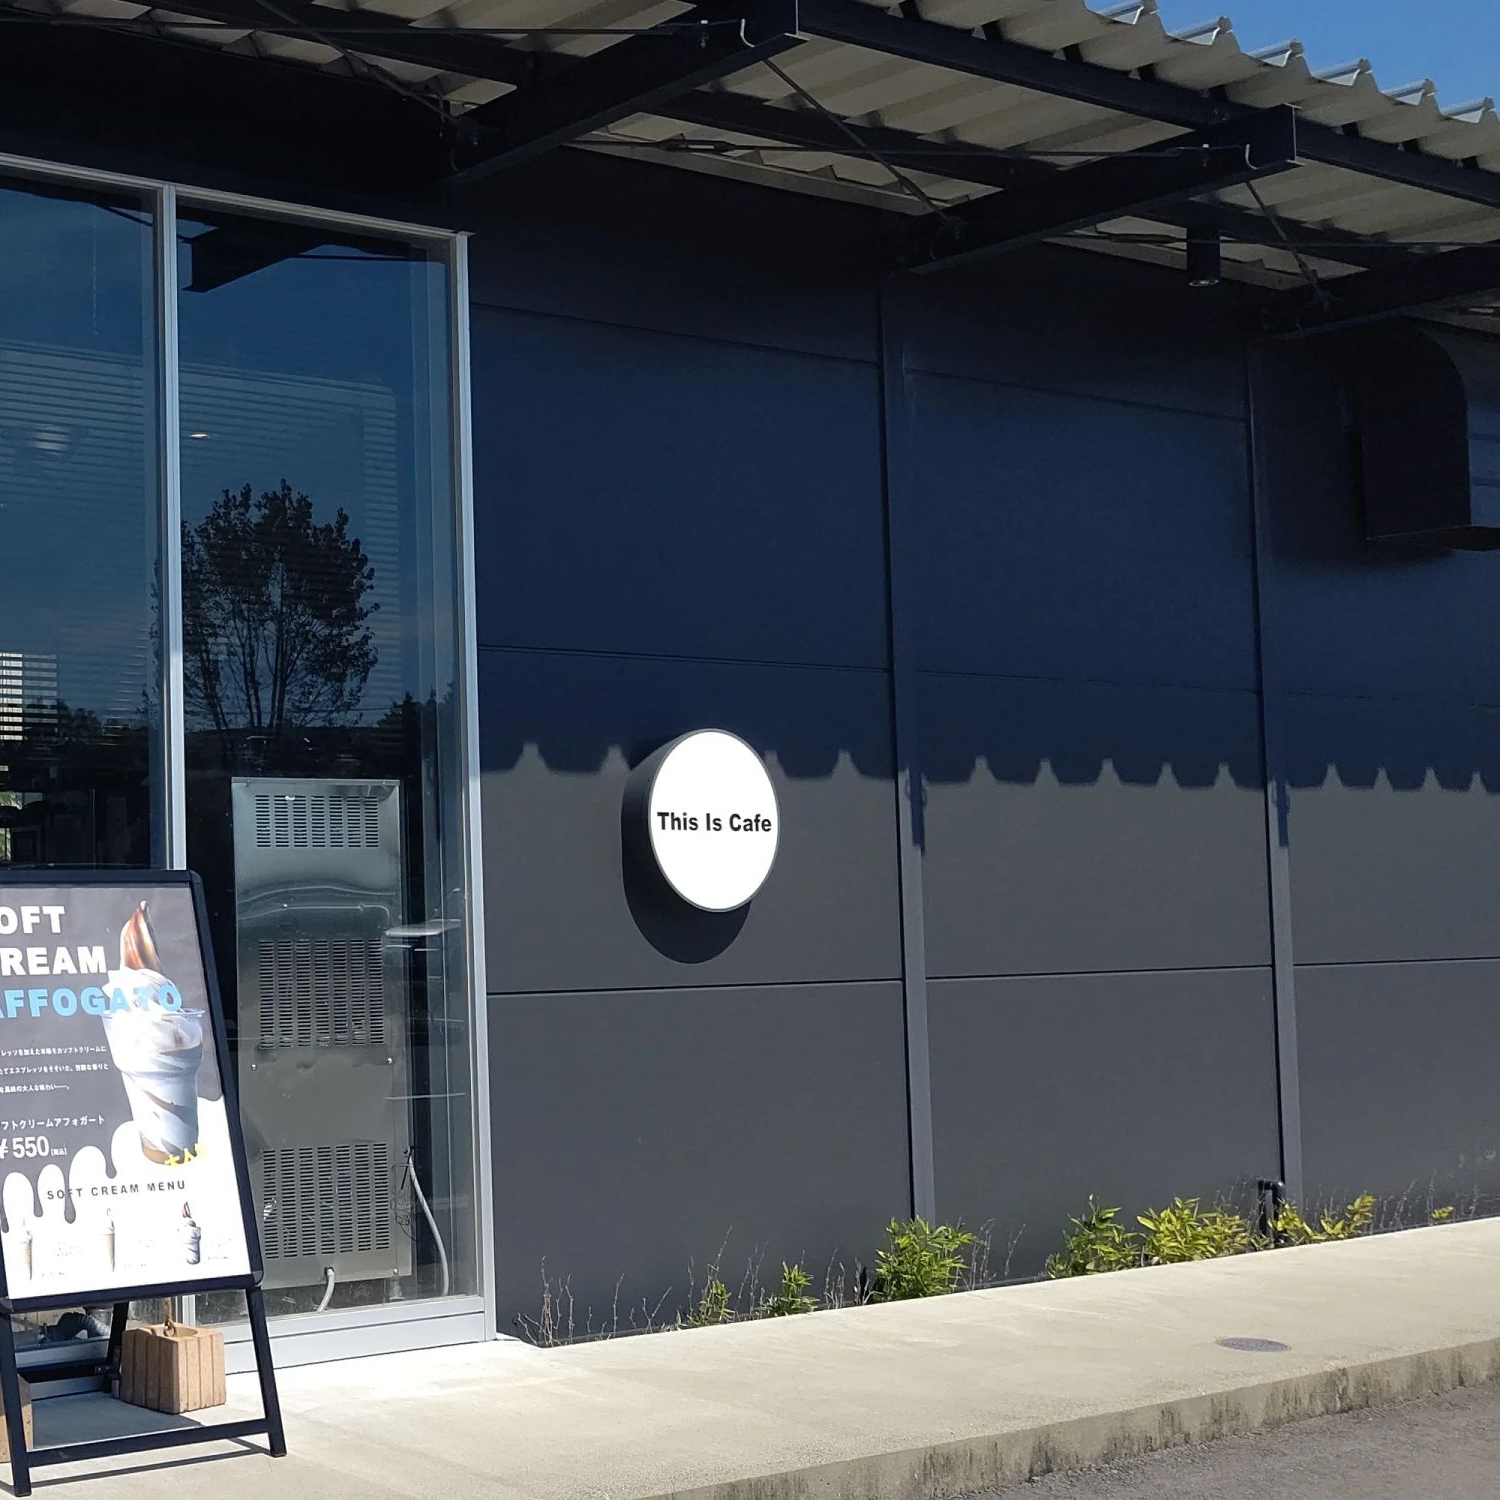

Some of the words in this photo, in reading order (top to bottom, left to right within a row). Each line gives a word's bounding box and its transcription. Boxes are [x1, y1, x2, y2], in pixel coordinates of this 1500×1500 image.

[657, 812, 699, 831] This
[706, 813, 722, 832] Is
[729, 813, 772, 832] Cafe
[47, 1188, 82, 1200] SOFT
[91, 1184, 139, 1197] CREAM
[147, 1180, 186, 1192] MENU
